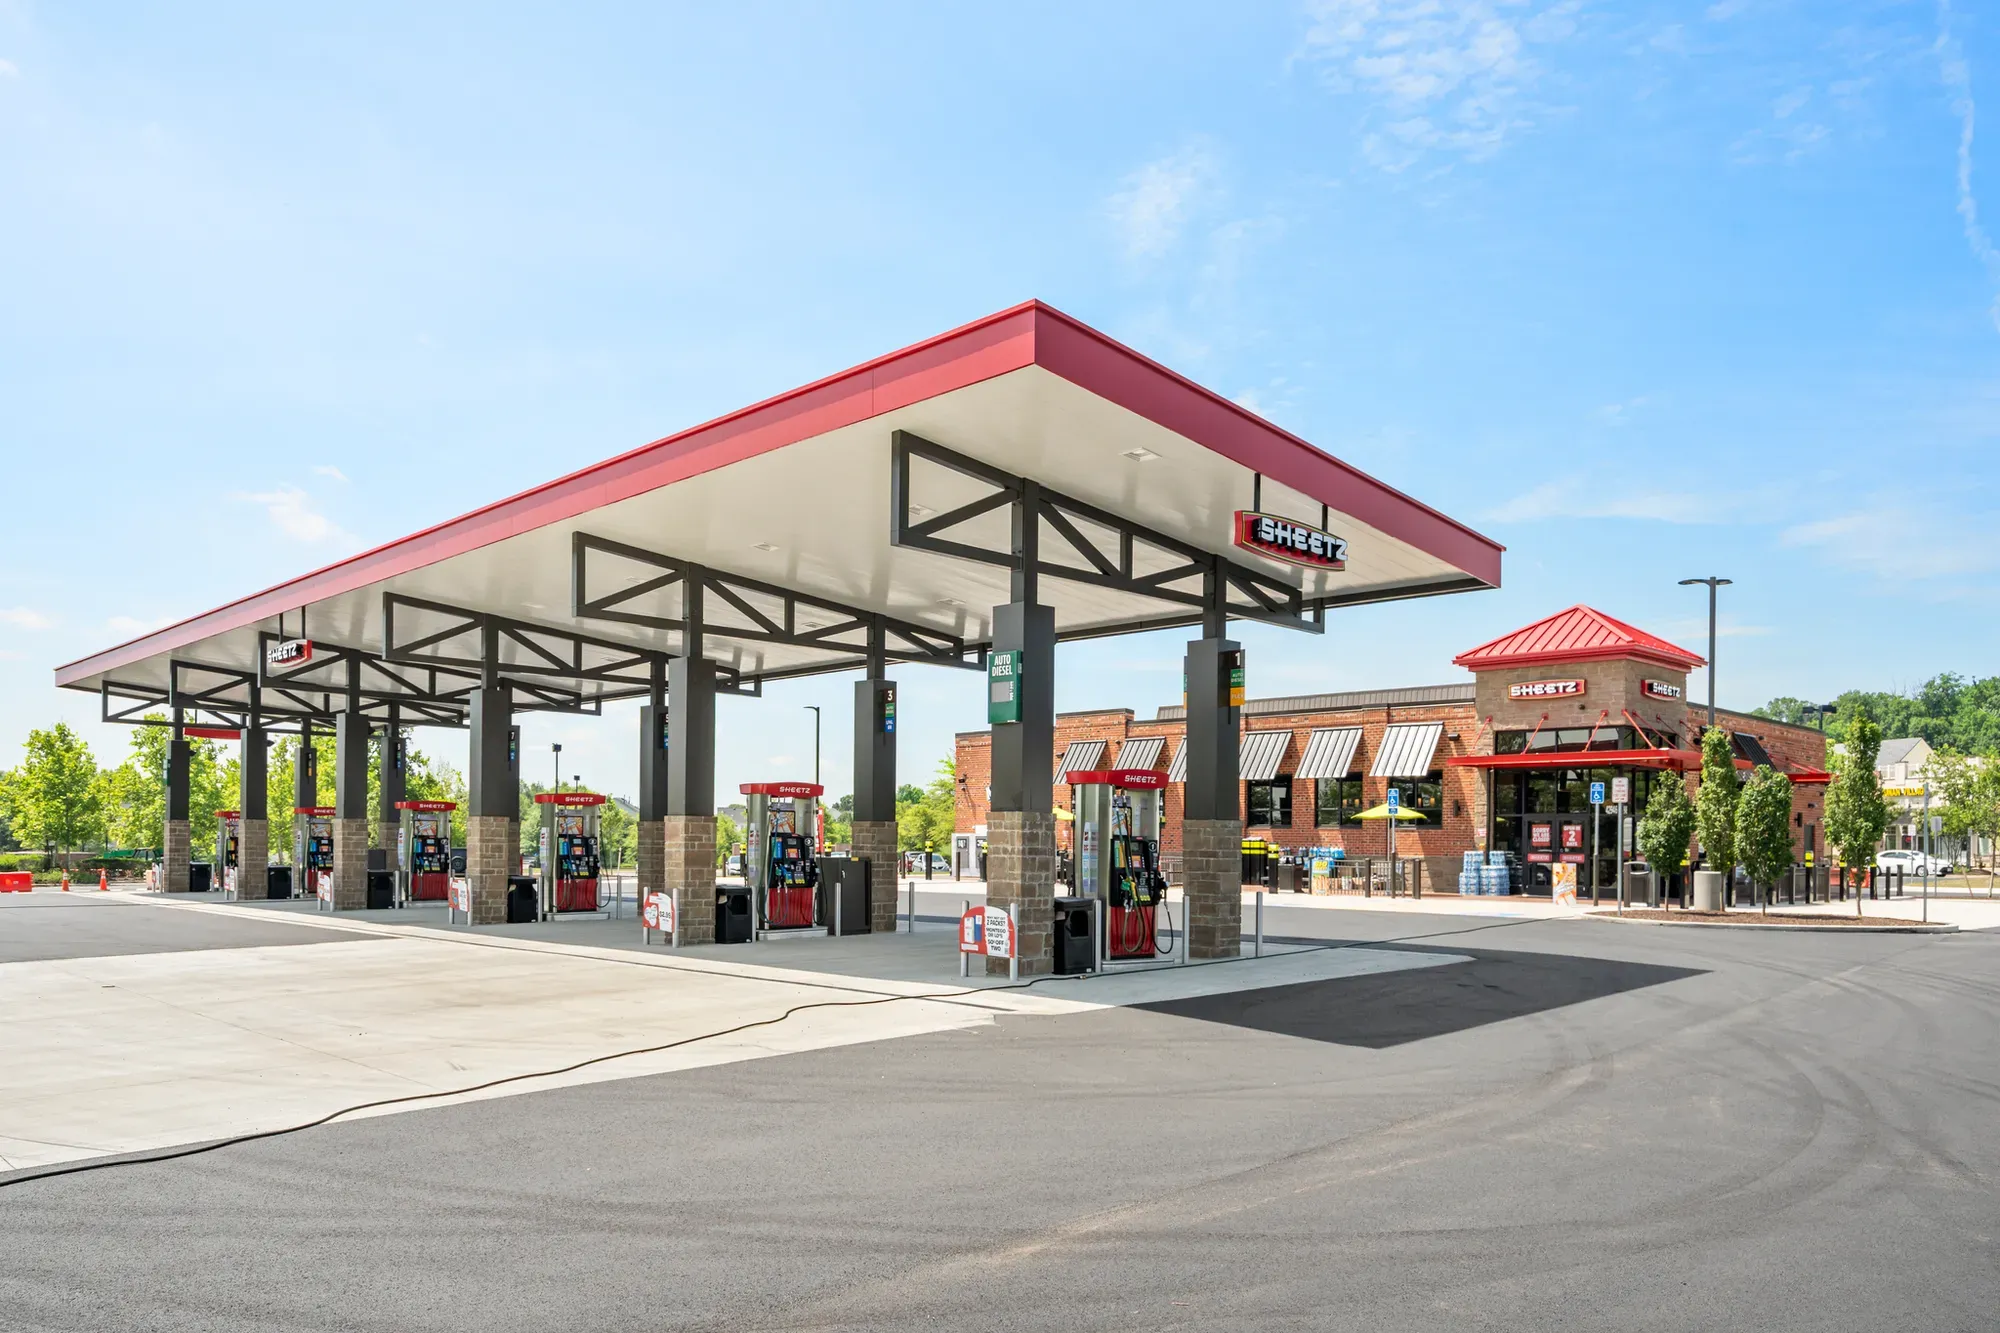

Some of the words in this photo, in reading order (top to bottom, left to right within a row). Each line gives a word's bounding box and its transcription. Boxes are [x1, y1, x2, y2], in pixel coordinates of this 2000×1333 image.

[1260, 517, 1348, 561] SHEETZ
[267, 643, 297, 663] SHEETZ
[1235, 652, 1240, 666] 1
[994, 654, 1011, 666] AUTO
[991, 665, 1013, 677] DIESEL
[1510, 681, 1577, 697] SHEETZ
[1652, 682, 1681, 698] SHEETZ
[887, 690, 893, 701] 3
[1124, 774, 1157, 784] SHEETZ
[779, 786, 811, 794] SHEETZ
[1903, 787, 1924, 796] VILLAG
[1568, 830, 1576, 842] 2
